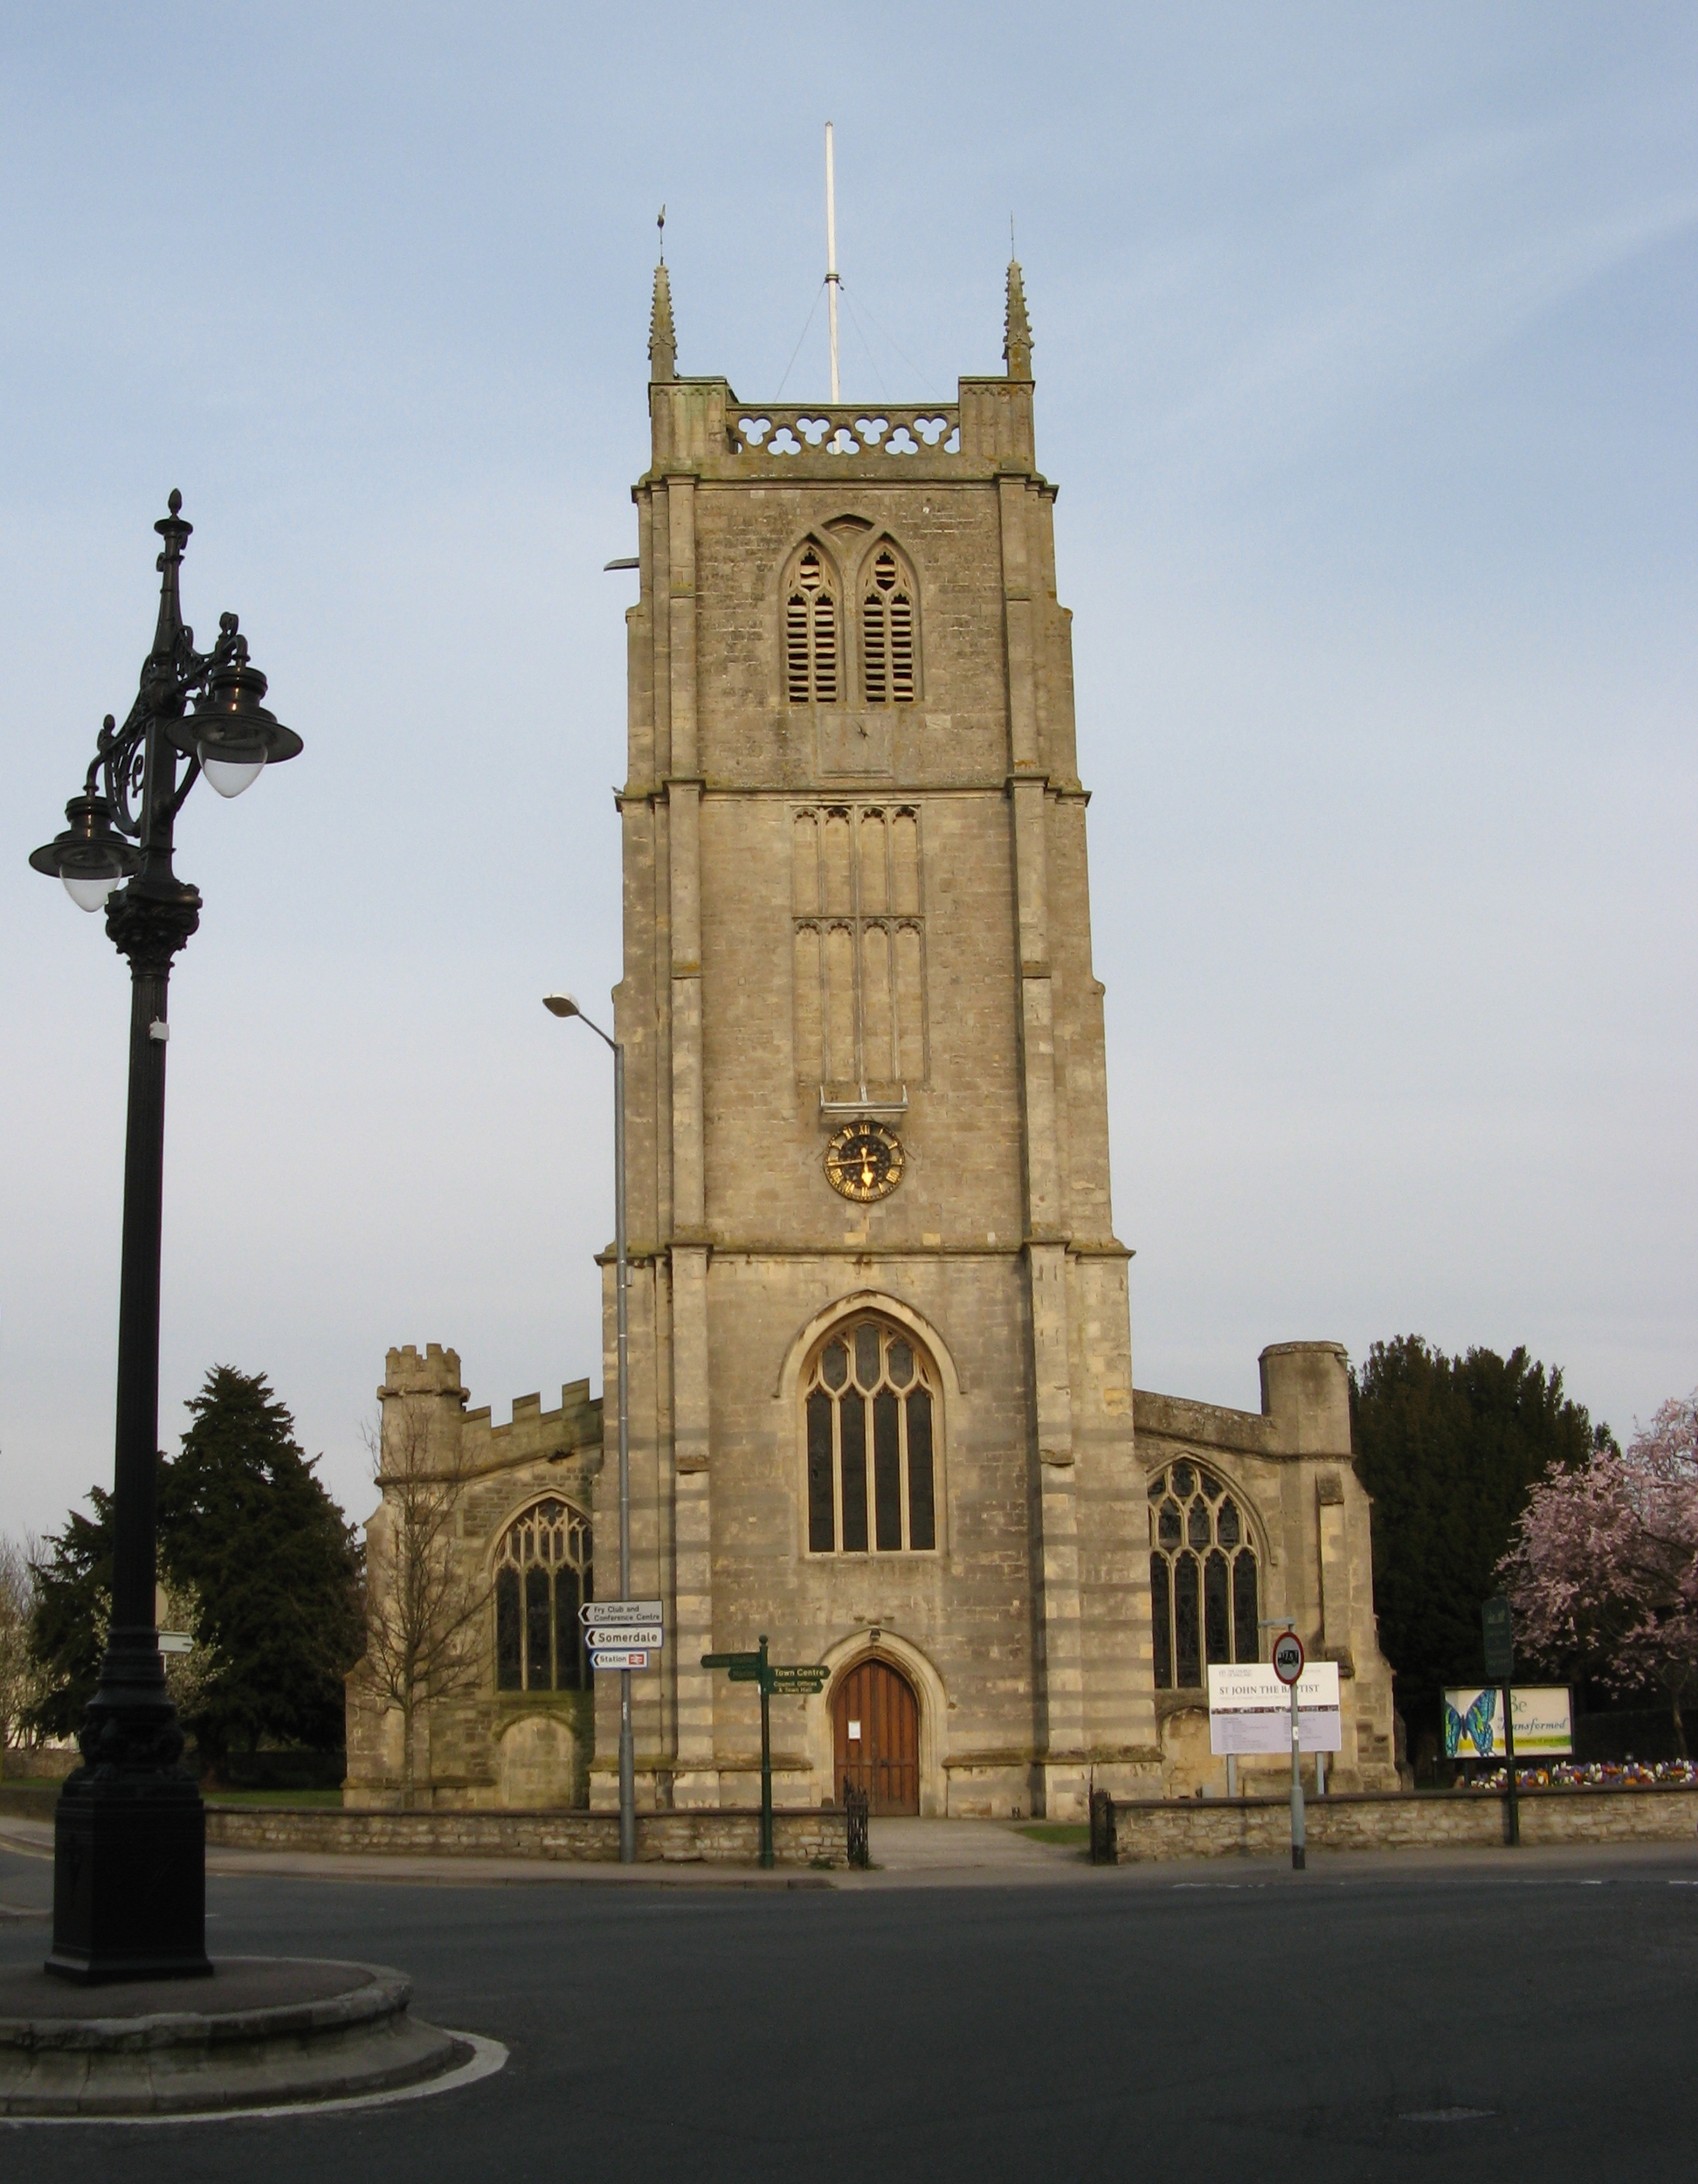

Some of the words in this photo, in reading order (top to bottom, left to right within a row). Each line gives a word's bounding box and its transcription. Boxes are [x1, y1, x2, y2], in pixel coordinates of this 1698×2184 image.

[594, 1606, 604, 1614] Fry
[598, 1632, 658, 1642] Somerdale
[797, 1668, 825, 1676] Centre
[1232, 1686, 1257, 1696] JOHN
[1260, 1685, 1279, 1694] THE
[1281, 1684, 1320, 1694] BATIST
